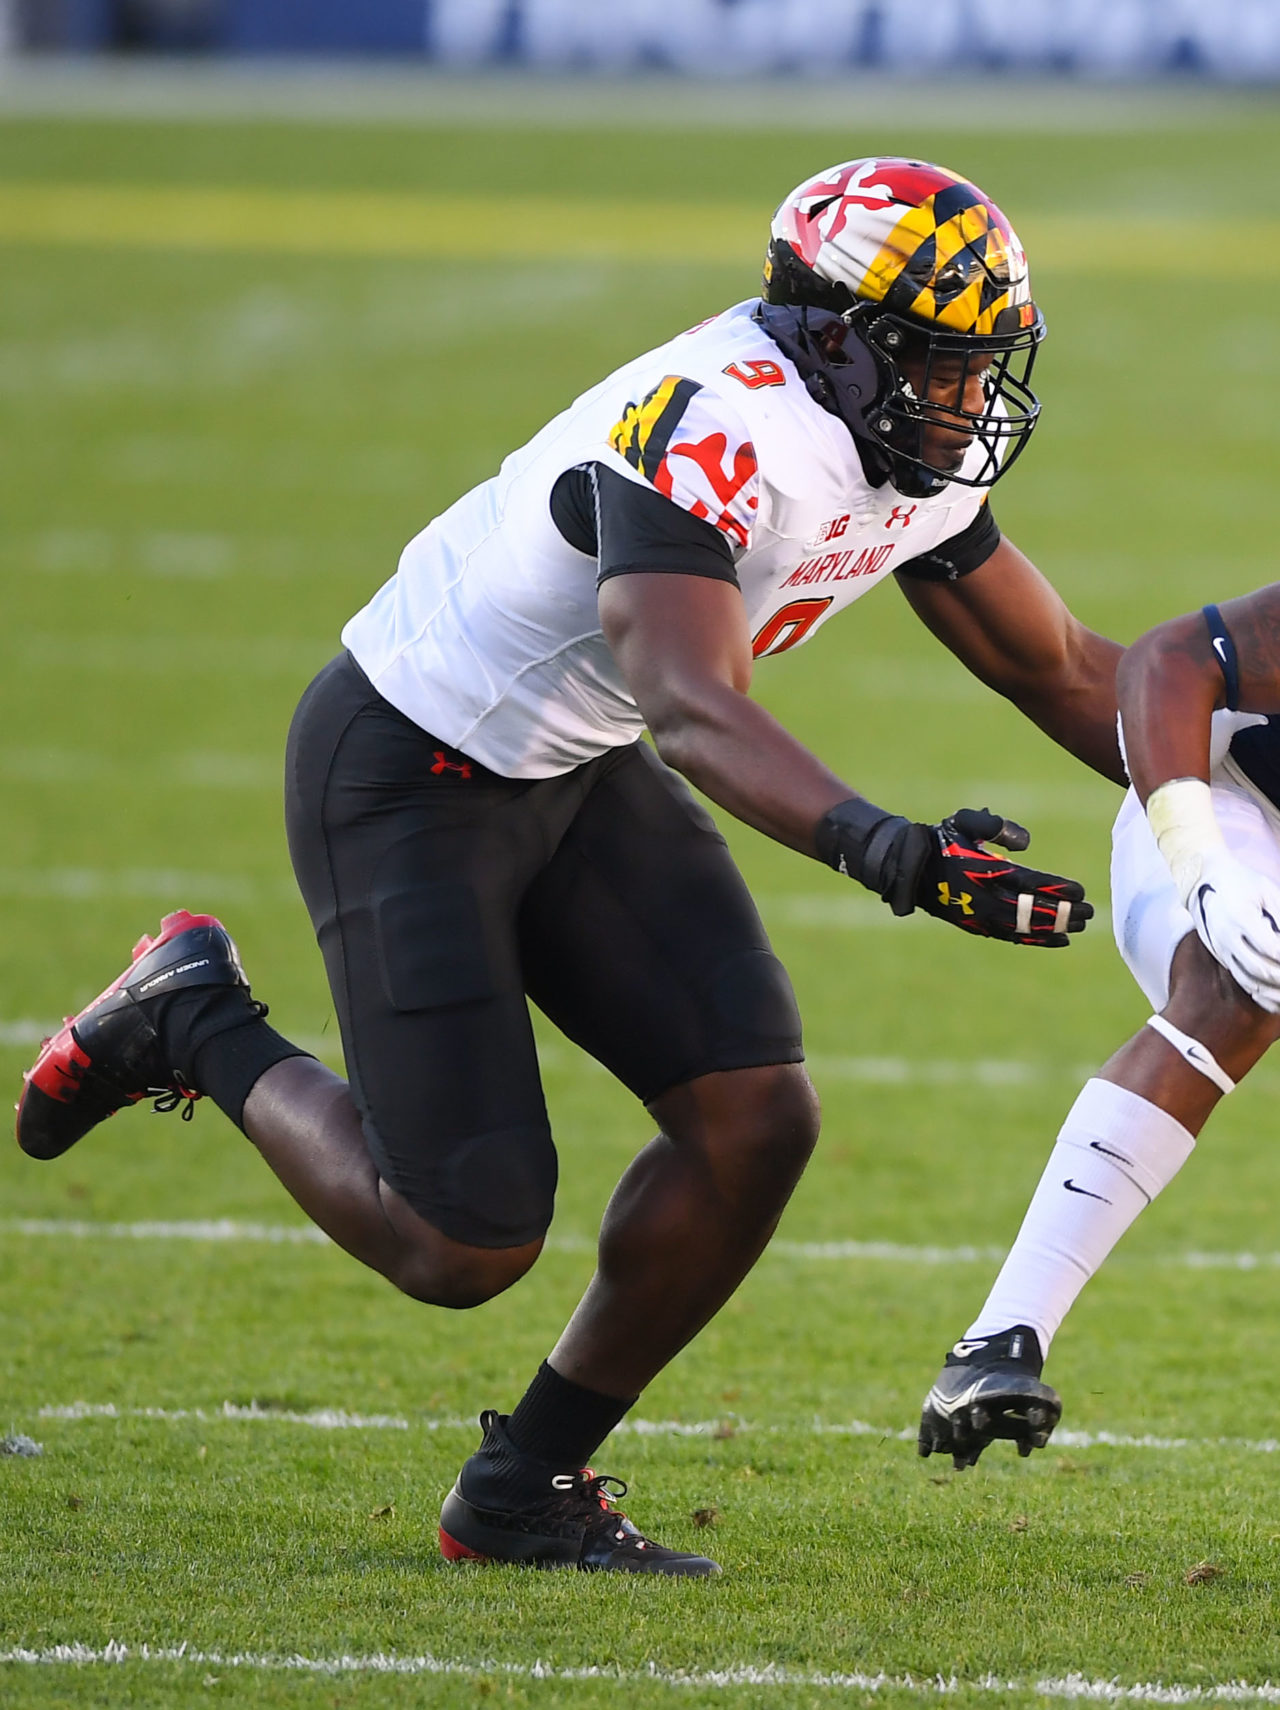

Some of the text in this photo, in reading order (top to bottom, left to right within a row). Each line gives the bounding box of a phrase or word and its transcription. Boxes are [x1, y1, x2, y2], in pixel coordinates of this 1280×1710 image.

[721, 360, 786, 389] 9
[779, 543, 895, 589] MARYLAND
[140, 959, 209, 992] UNDER ARMOUR
